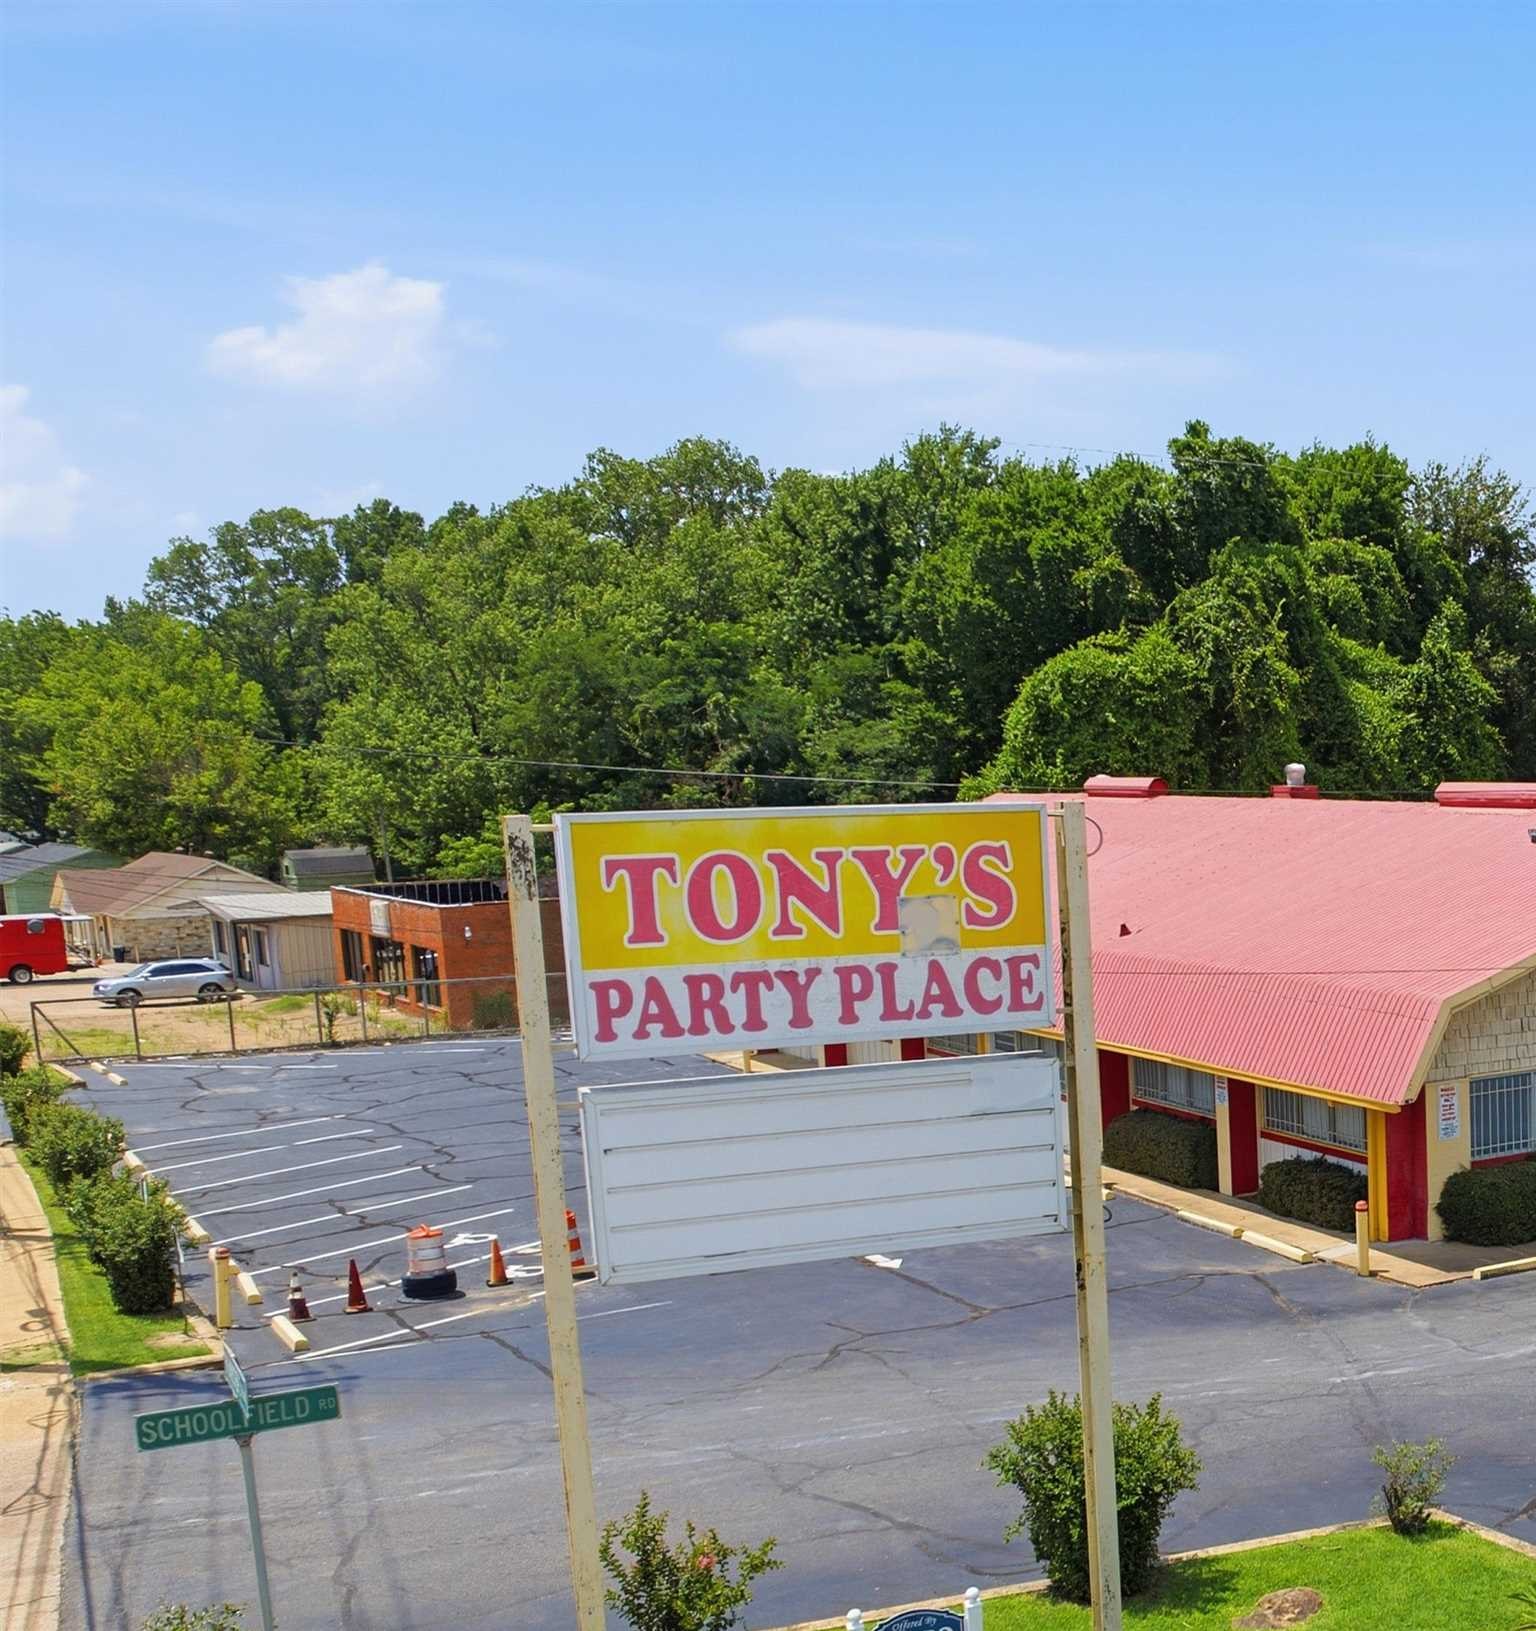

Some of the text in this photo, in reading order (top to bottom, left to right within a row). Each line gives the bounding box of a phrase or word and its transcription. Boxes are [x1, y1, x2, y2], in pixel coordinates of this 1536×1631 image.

[601, 840, 1018, 949] TONY'S
[589, 953, 1043, 1042] PARTY PLACE
[141, 1397, 336, 1444] SCHOOLFIELD RD
